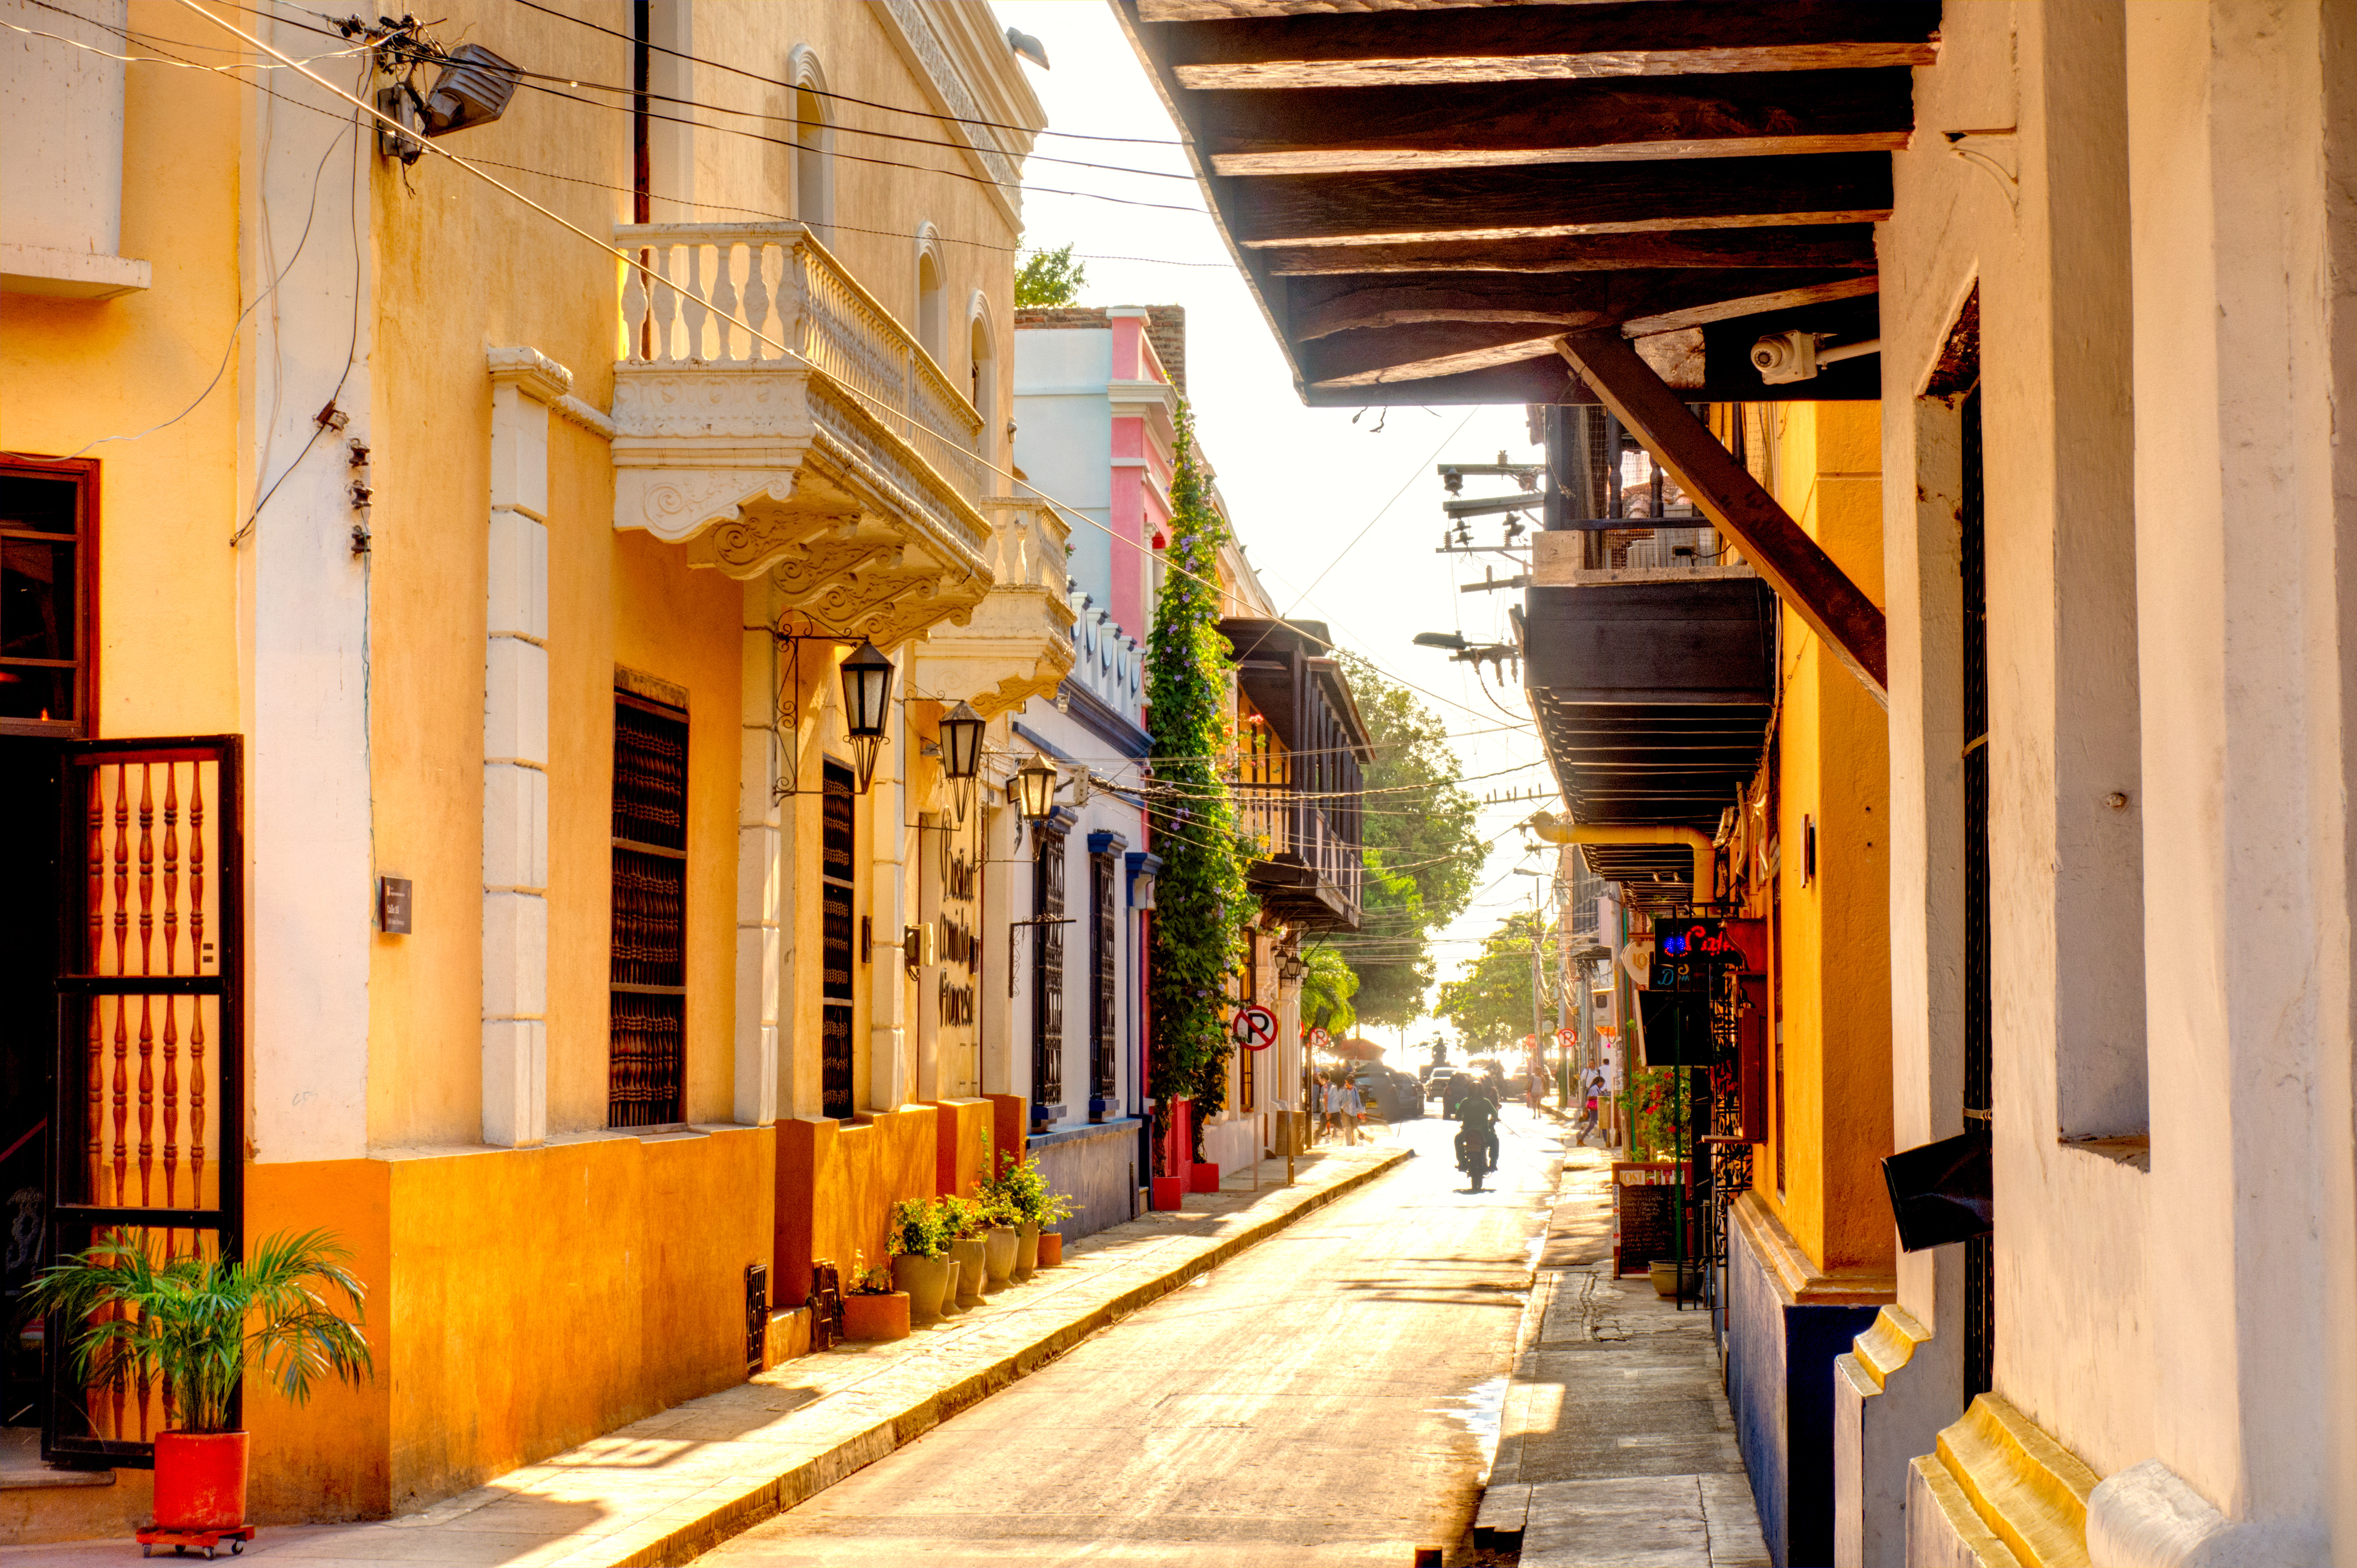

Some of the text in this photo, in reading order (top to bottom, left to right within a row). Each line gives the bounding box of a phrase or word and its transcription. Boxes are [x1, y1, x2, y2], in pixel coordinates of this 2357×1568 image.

[939, 907, 969, 966] Comida
[939, 968, 974, 1028] Francesa
[1248, 1013, 1269, 1043] P
[1316, 1030, 1325, 1044] P
[1564, 1031, 1572, 1044] P
